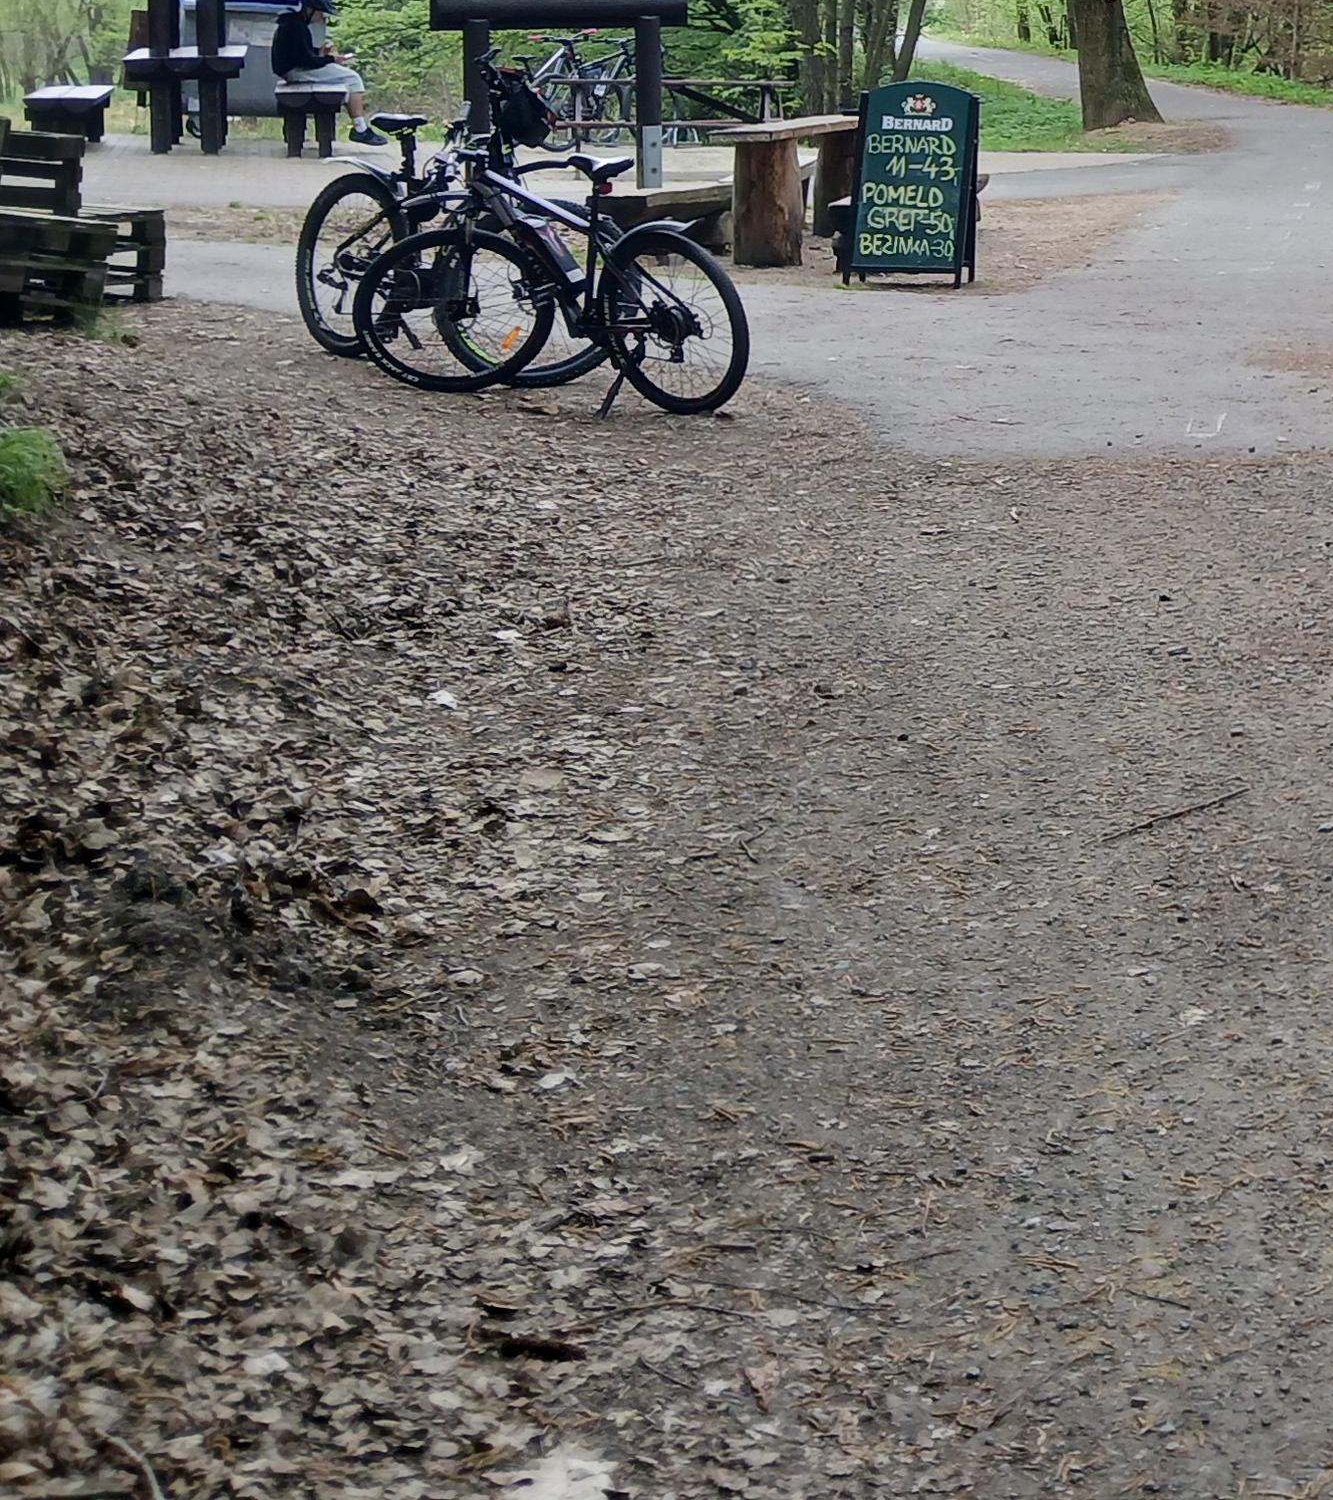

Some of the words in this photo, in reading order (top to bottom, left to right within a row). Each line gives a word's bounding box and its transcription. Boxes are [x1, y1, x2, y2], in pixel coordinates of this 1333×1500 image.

[881, 115, 954, 132] BERNARD
[867, 133, 957, 155] BERNARD
[862, 181, 944, 208] POMELO
